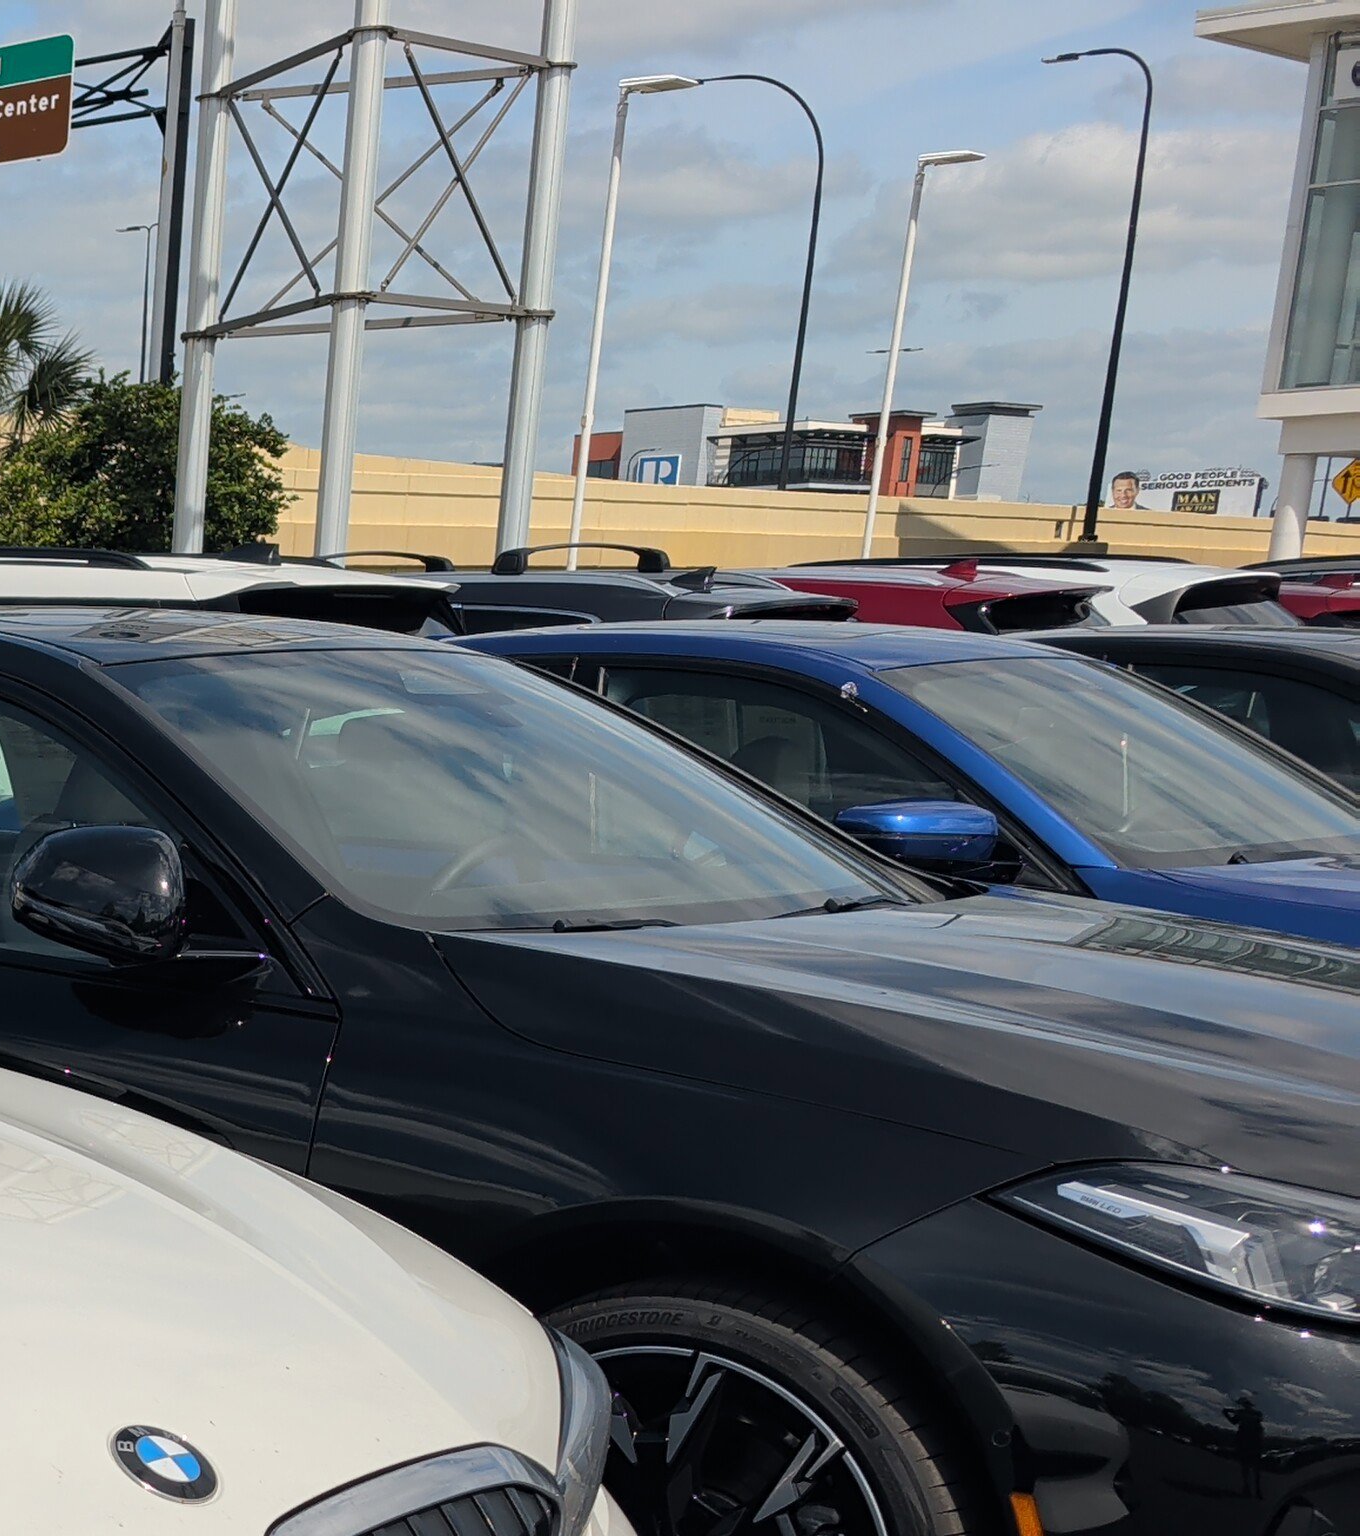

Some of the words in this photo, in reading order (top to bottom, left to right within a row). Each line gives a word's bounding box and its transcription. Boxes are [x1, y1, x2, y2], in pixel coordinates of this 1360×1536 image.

[1160, 472, 1192, 481] GOOD
[1194, 470, 1238, 480] PEOPLE
[1141, 481, 1189, 490] SERIOUS
[1191, 478, 1256, 489] ACCIDENTS
[1177, 493, 1217, 504] MAIN
[1100, 1202, 1122, 1215] LED
